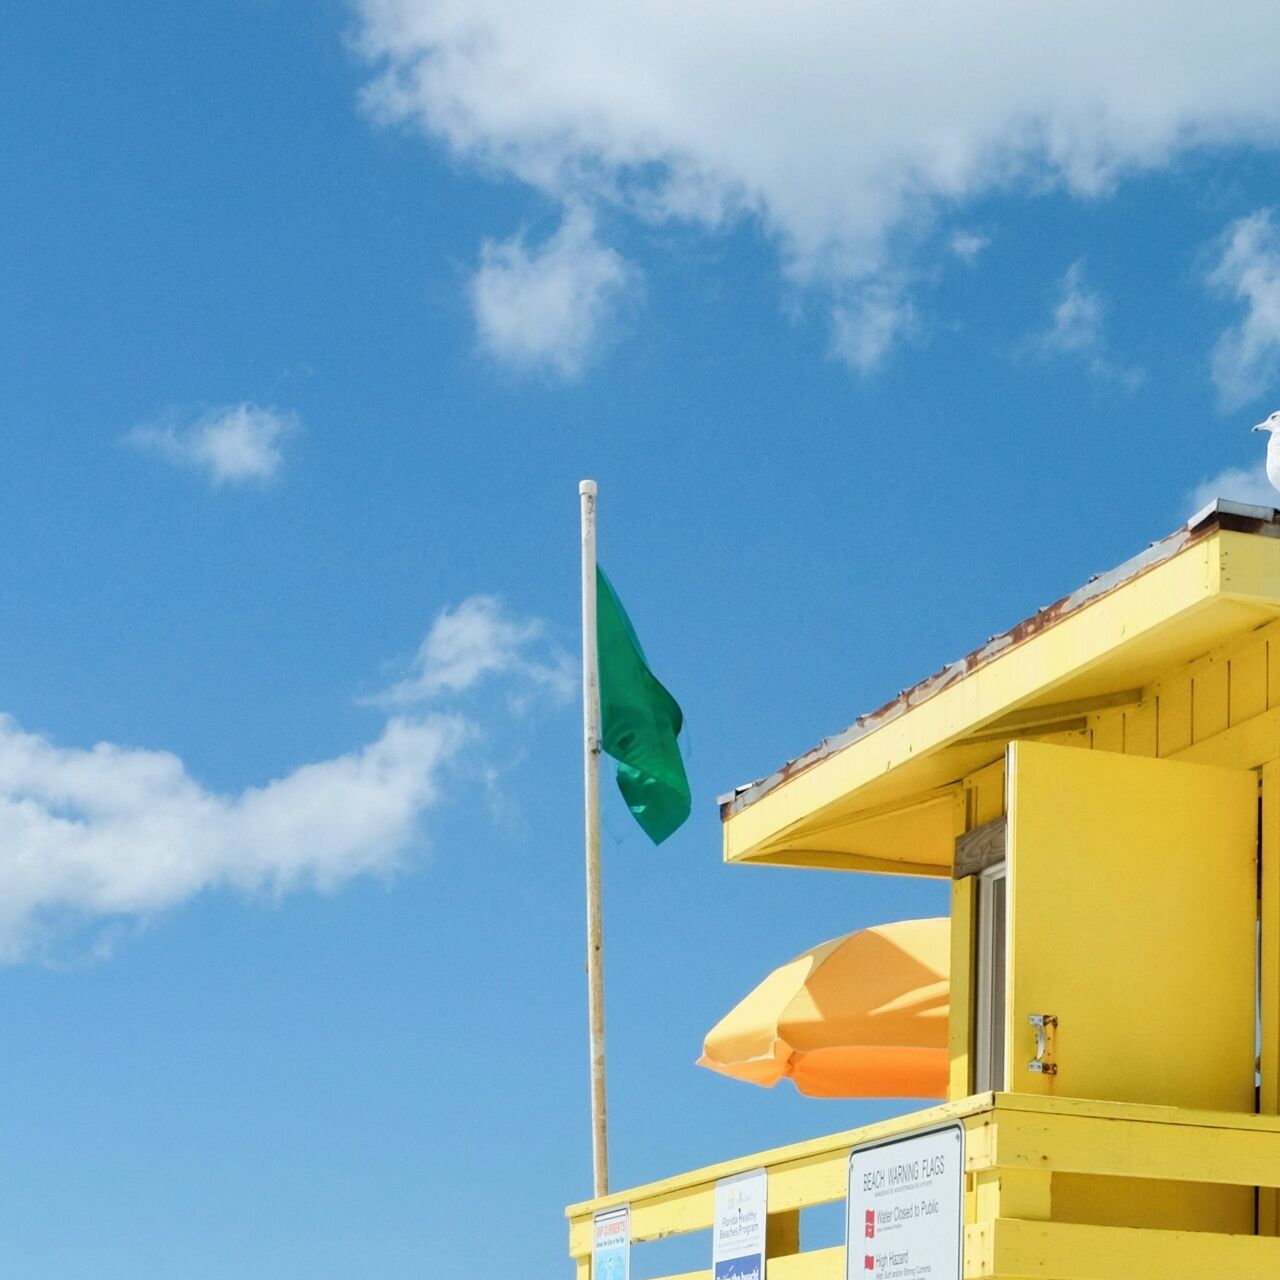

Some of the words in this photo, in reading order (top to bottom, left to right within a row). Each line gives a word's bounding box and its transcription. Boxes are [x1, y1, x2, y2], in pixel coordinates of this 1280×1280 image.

[864, 1169, 885, 1191] BEACH
[888, 1161, 919, 1185] WARNING
[922, 1155, 944, 1178] FLAGS
[722, 1216, 739, 1227] Florida
[739, 1210, 757, 1224] Healthy
[877, 1209, 893, 1224] Water
[894, 1205, 913, 1222] Closed
[914, 1205, 919, 1216] to
[921, 1199, 939, 1215] Public
[720, 1227, 739, 1240] Beaches
[739, 1223, 759, 1236] Program
[876, 1253, 888, 1271] High
[889, 1249, 908, 1266] Hazard
